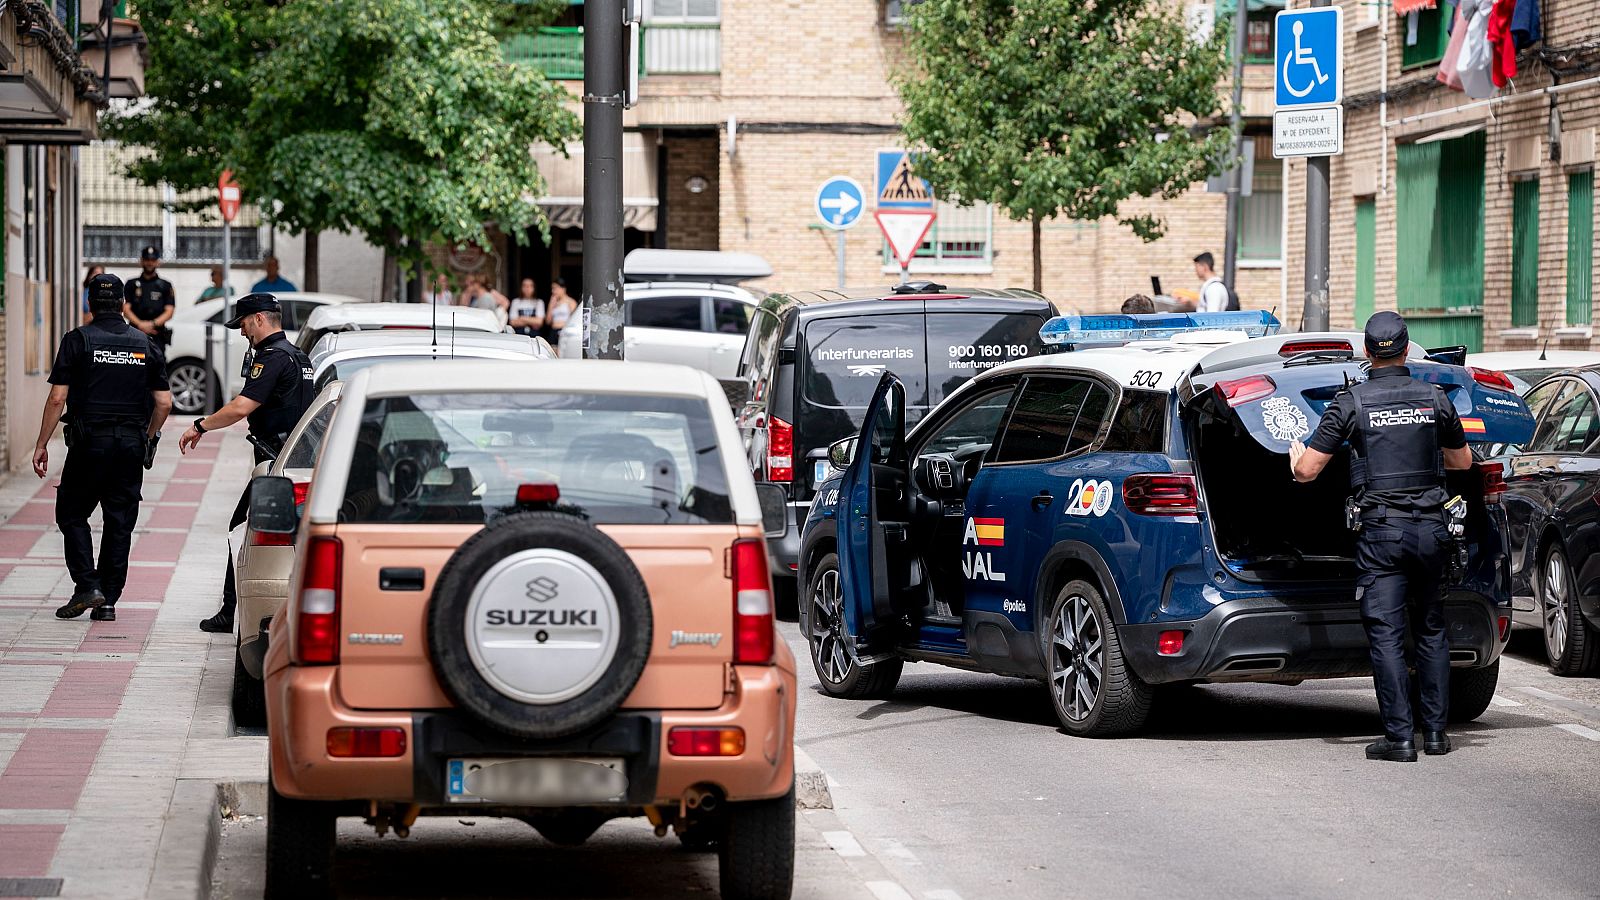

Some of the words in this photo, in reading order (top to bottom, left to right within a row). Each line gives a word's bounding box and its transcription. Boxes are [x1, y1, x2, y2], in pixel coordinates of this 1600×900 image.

[1288, 116, 1318, 124] RESERVADA
[1299, 127, 1330, 136] EXPEDIENTE
[94, 350, 135, 358] POLICIA
[818, 347, 914, 360] Interfunerarias
[949, 346, 976, 357] 900
[979, 345, 1002, 356] 160
[1005, 344, 1028, 356] 160
[94, 356, 146, 366] NACIONAL
[1369, 408, 1422, 420] POLICIA
[1370, 416, 1436, 428] NACIONAL
[1065, 478, 1114, 516] 200
[486, 610, 596, 626] SUZUKI
